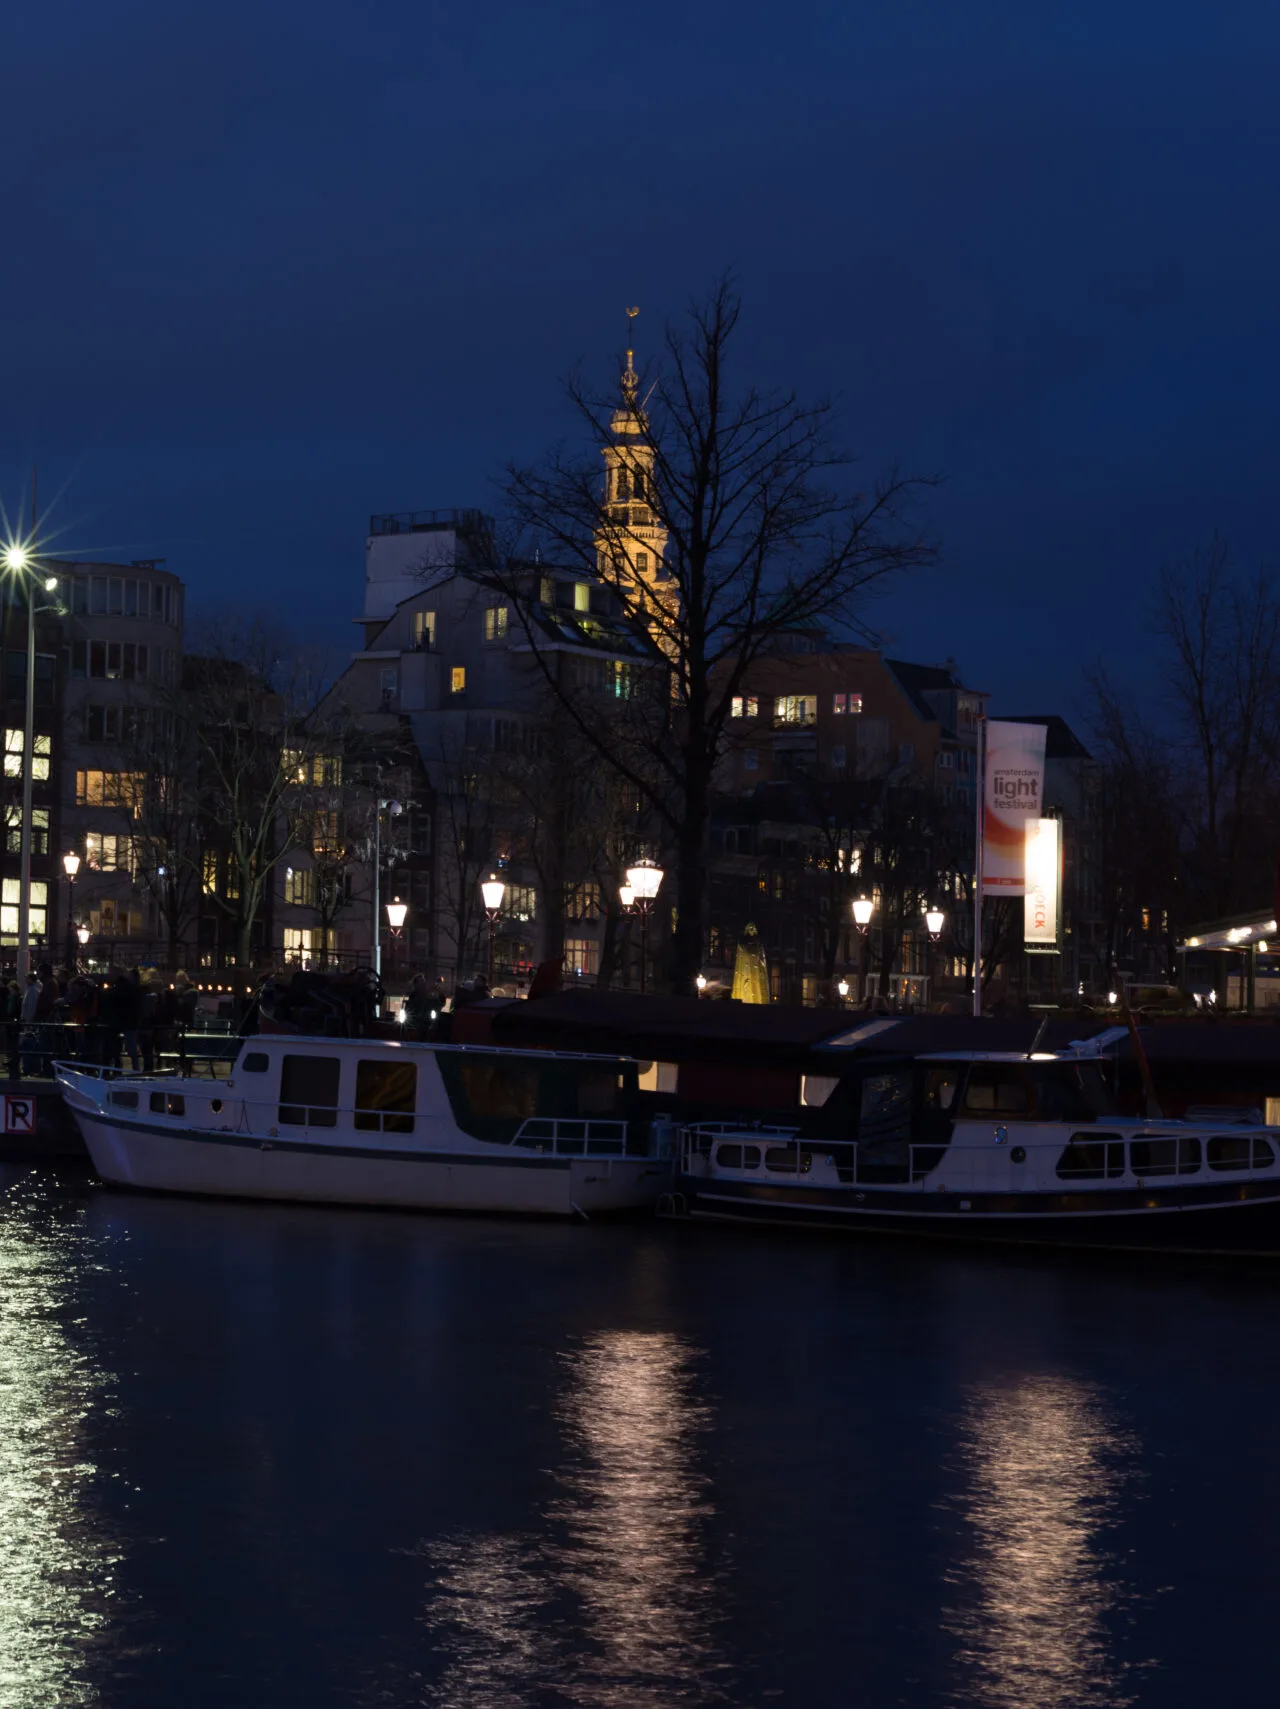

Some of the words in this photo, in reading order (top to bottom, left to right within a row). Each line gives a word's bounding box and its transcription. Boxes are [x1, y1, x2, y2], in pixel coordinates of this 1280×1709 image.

[994, 768, 1040, 776] amsterdam
[994, 776, 1038, 799] light
[994, 798, 1038, 810] festival
